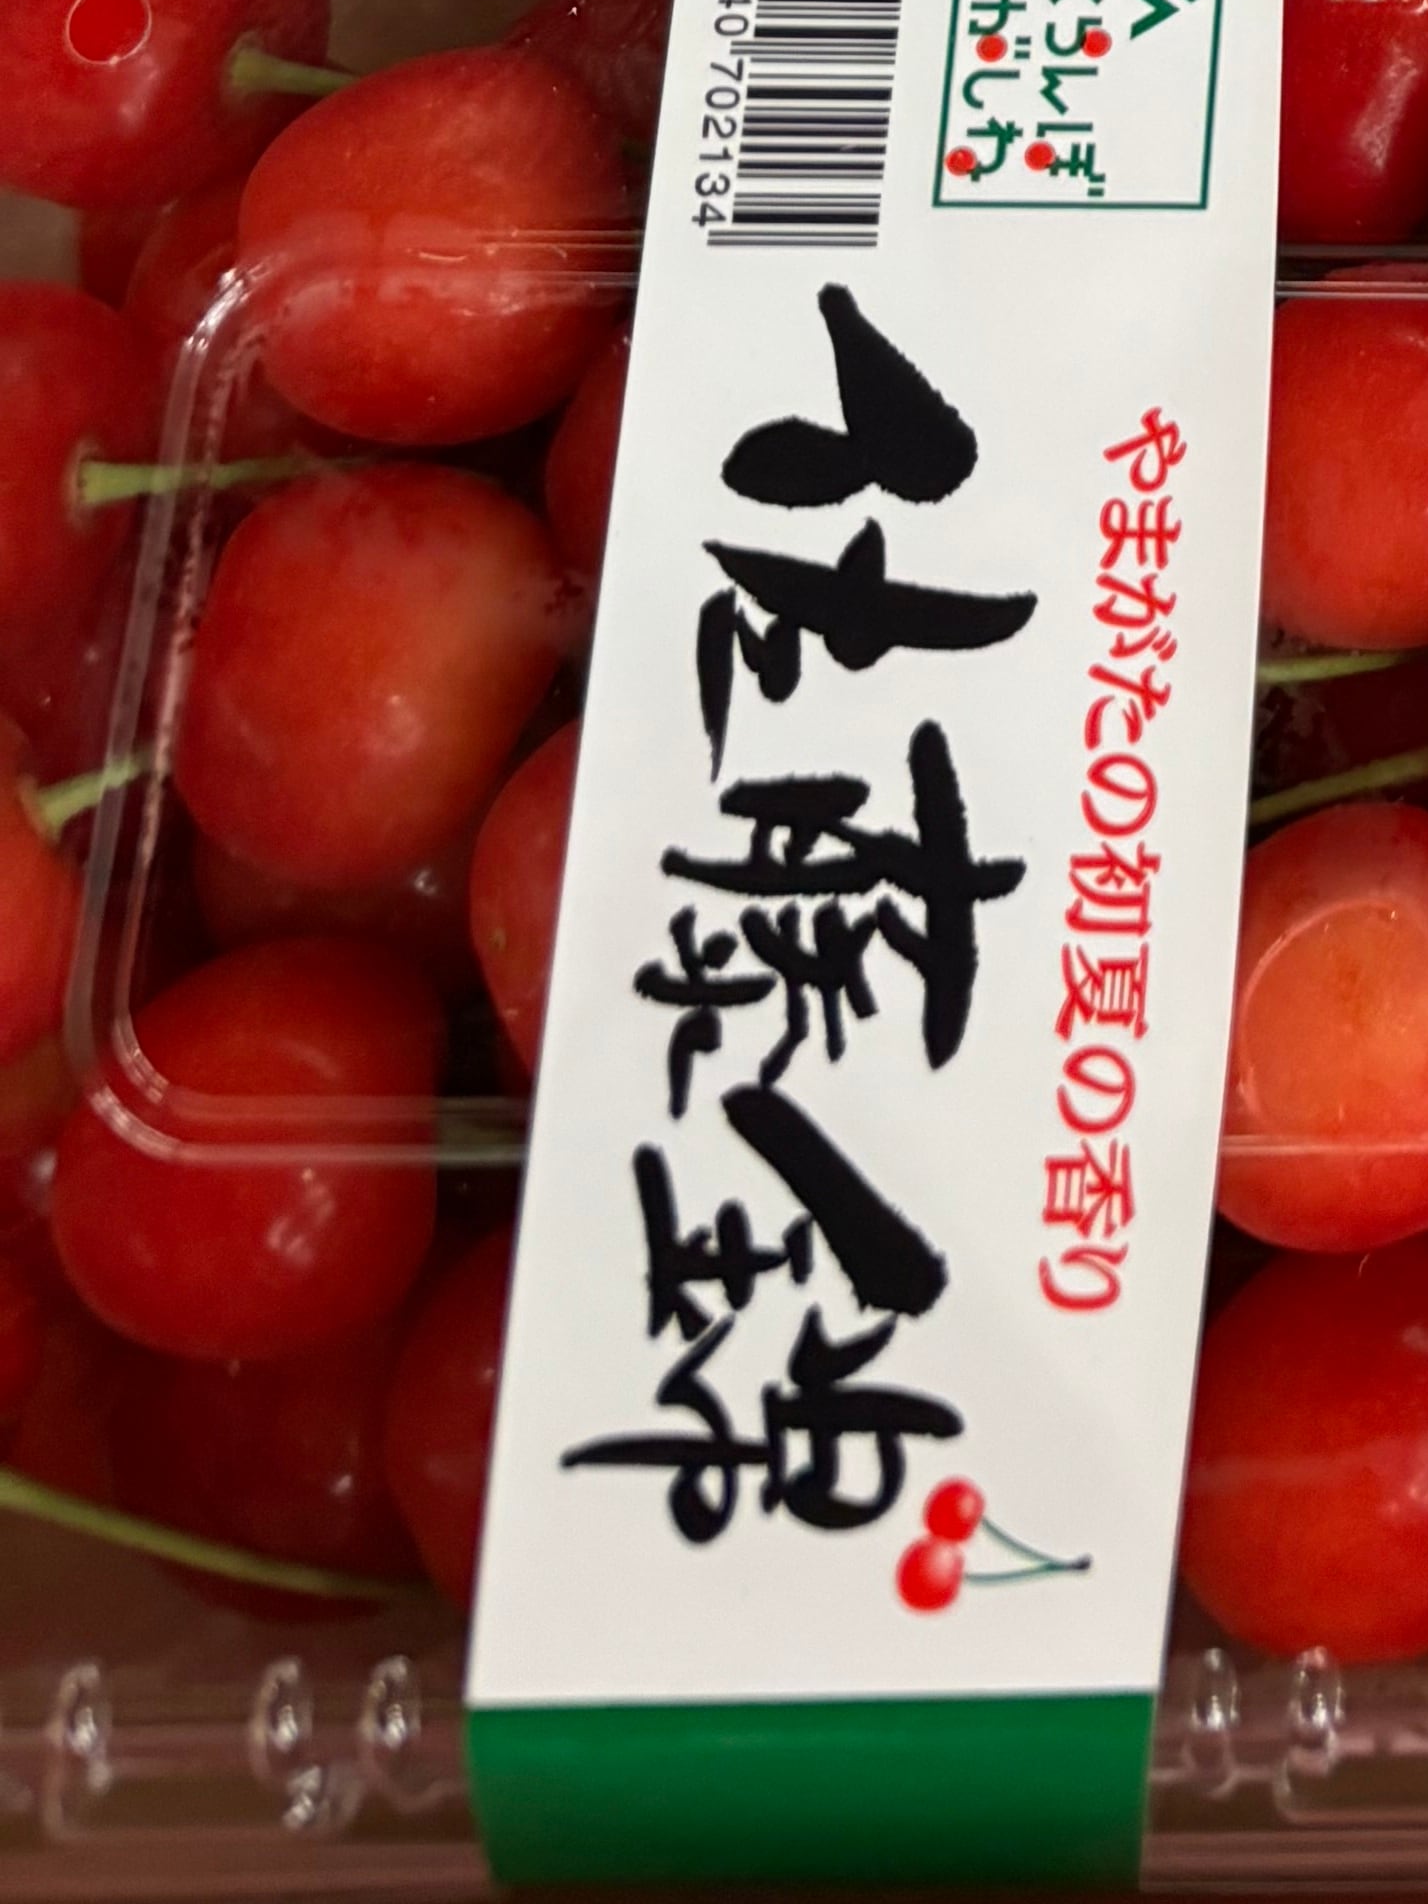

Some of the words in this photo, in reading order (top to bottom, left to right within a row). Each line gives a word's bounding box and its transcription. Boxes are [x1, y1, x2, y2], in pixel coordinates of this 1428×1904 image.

[691, 58, 743, 227] 702134
[562, 285, 1037, 1544] 佐藤錦
[1036, 407, 1188, 1315] やまがたの初夏の香り
